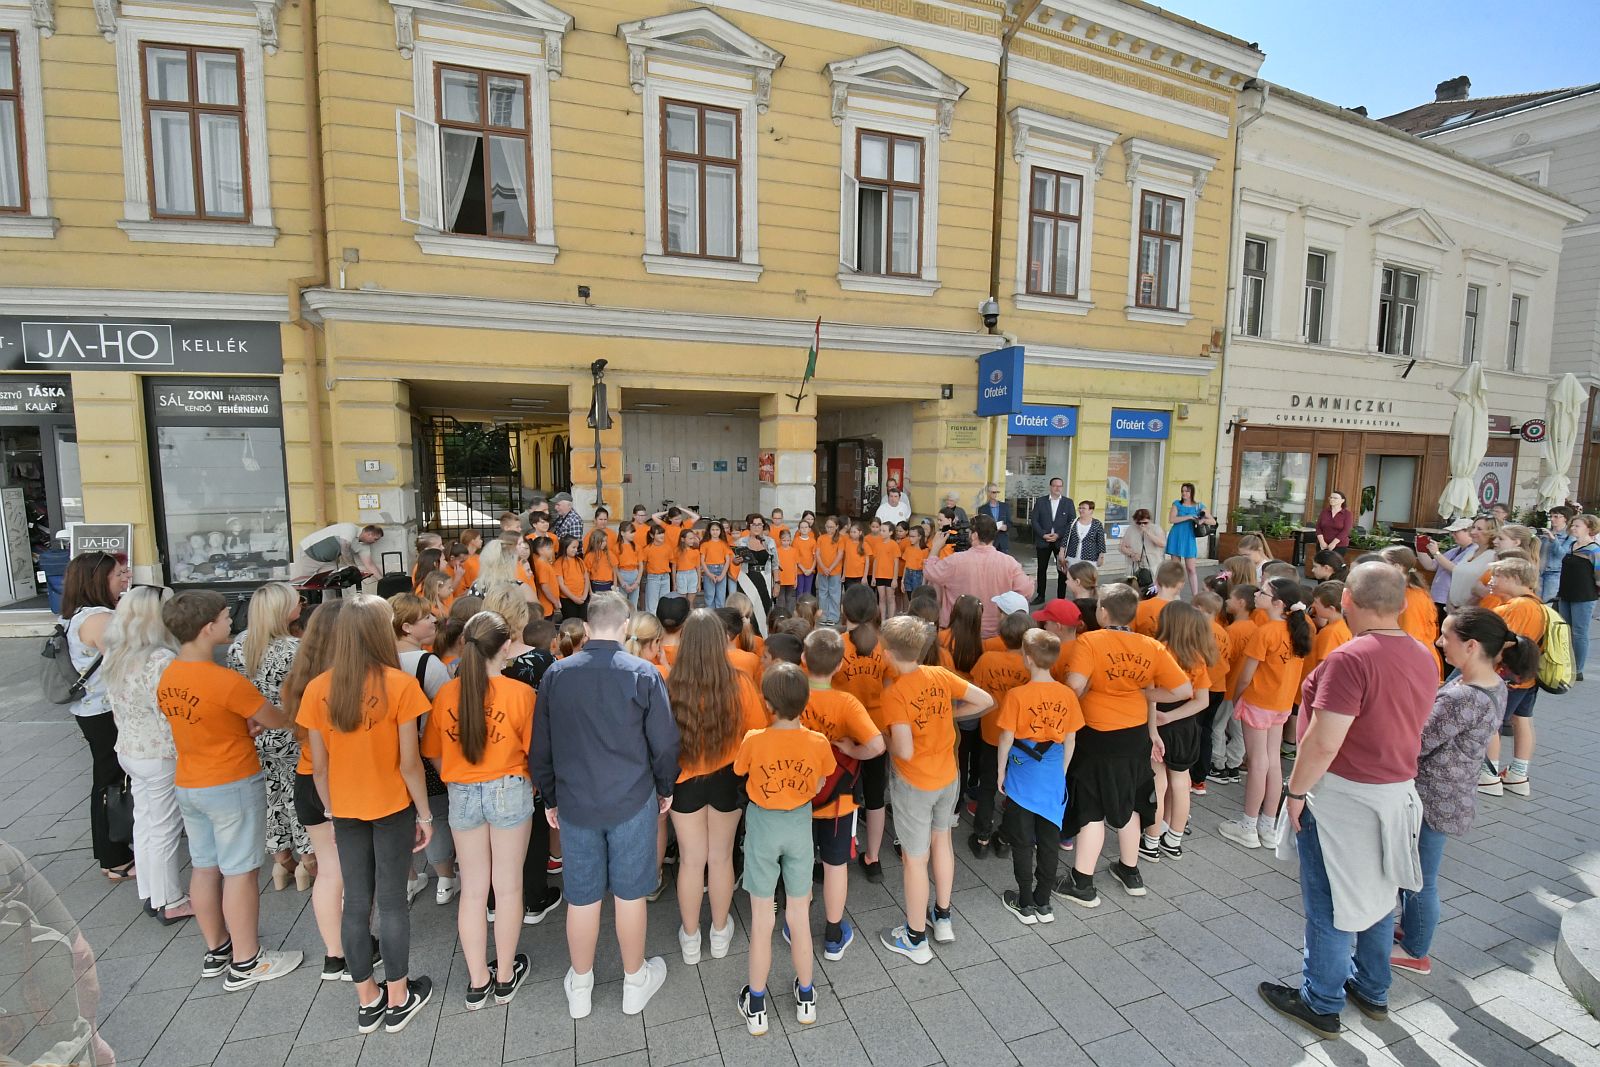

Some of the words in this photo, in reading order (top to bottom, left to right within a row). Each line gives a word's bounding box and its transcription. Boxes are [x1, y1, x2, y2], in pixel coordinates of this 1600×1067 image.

[38, 323, 159, 363] JA-HO
[182, 338, 248, 353] KELLÉK
[27, 385, 66, 397] TÁSKA
[984, 385, 1008, 399] Ofotért
[160, 393, 185, 407] SÁL
[188, 390, 224, 400] ZOKNI
[228, 394, 270, 402] HARISNYA
[1291, 394, 1393, 413] DAMNICZKI
[25, 402, 58, 411] KALAP
[218, 404, 269, 414] FEHÉRNEMŰ
[1015, 414, 1049, 427] Ofotért
[1116, 419, 1145, 430] Ofotért
[1276, 414, 1325, 423] CUKRÁSZ
[83, 537, 120, 549] JA-HO
[1106, 652, 1151, 669] István
[1028, 700, 1068, 717] István
[760, 758, 814, 780] István
[760, 775, 810, 800] Király
